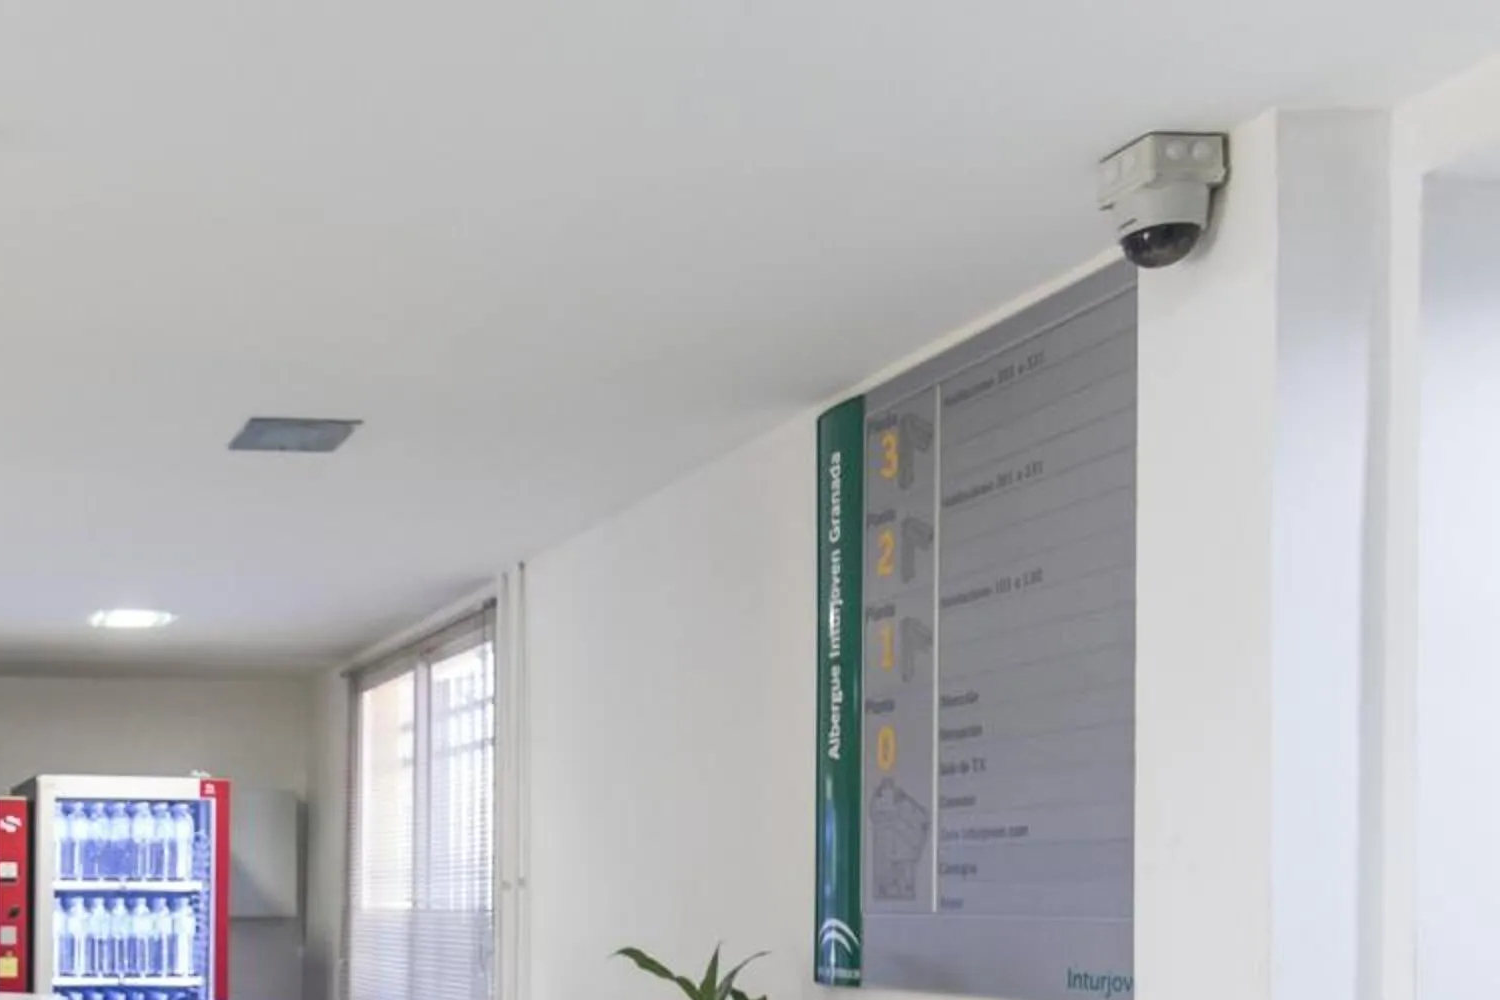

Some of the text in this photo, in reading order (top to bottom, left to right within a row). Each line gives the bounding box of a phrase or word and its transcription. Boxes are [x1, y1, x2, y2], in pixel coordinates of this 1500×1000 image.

[880, 431, 898, 479] 3
[877, 530, 895, 576] 2
[829, 451, 844, 760] Albergue Inturjoven Granada
[880, 622, 895, 671] 1
[876, 724, 895, 772] 0
[1067, 966, 1134, 1000] Inturjov
